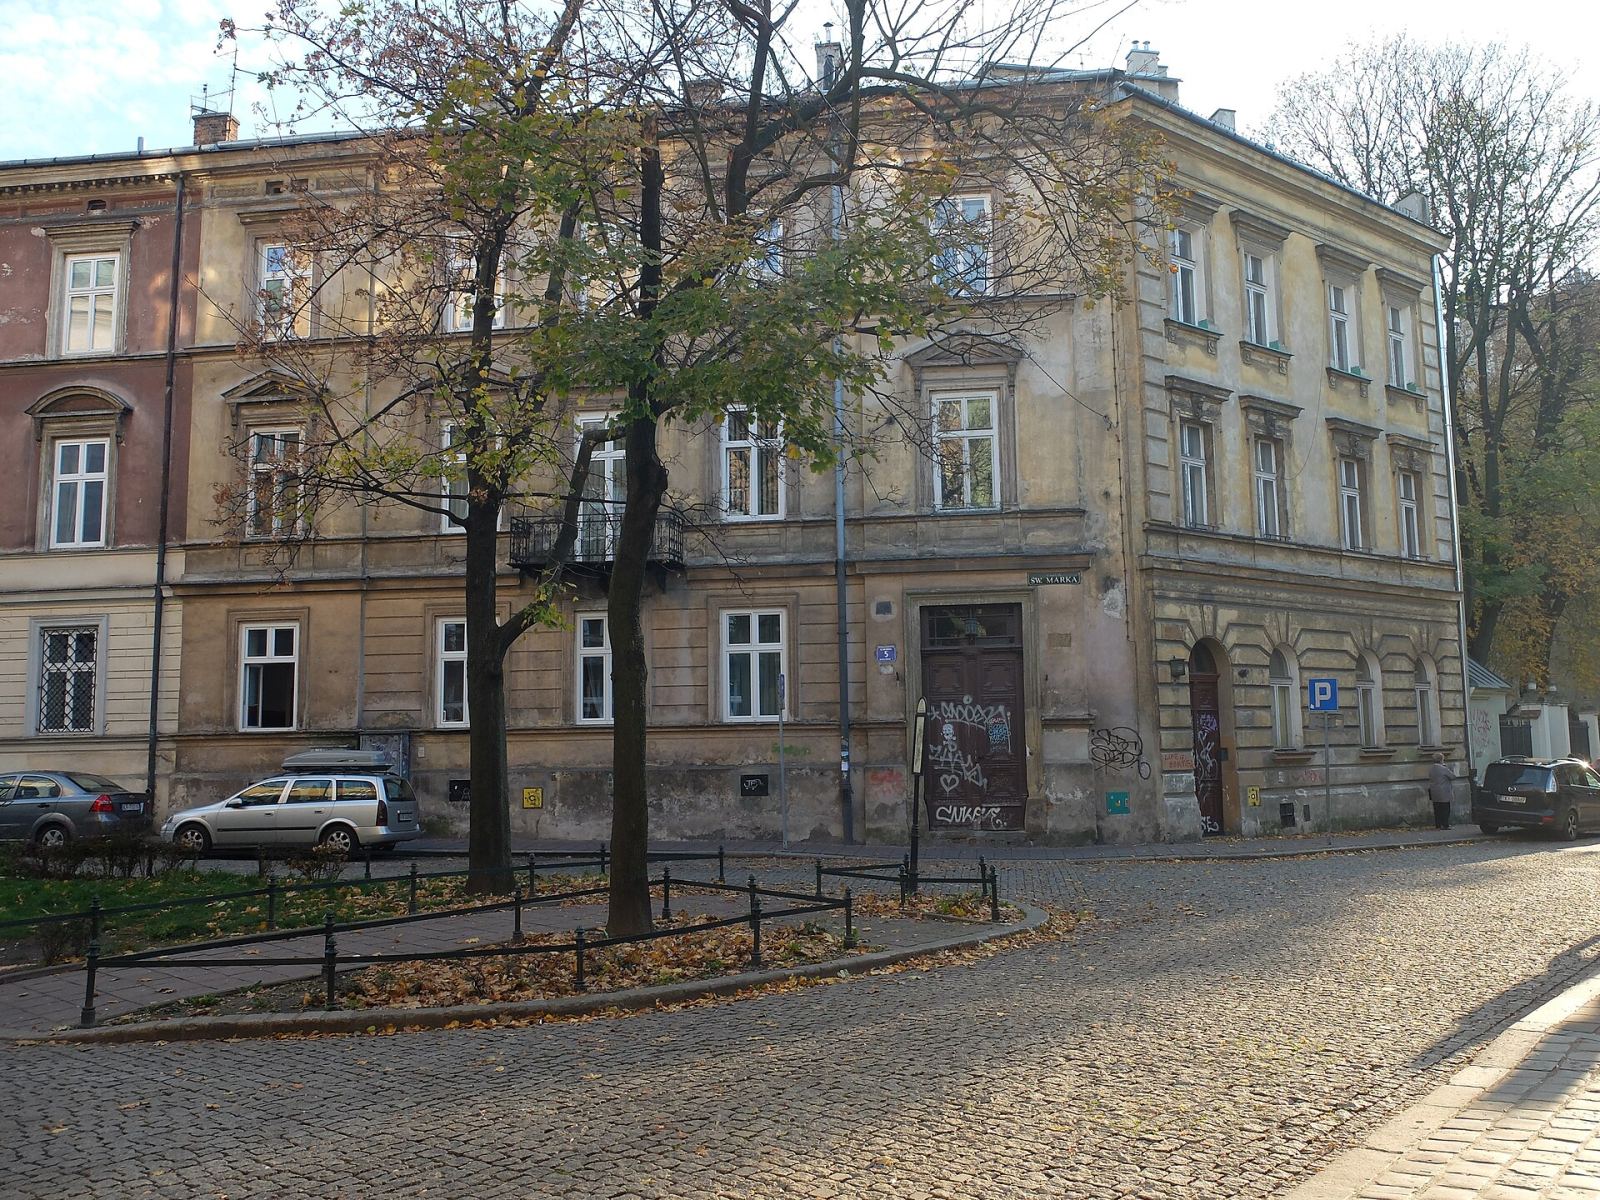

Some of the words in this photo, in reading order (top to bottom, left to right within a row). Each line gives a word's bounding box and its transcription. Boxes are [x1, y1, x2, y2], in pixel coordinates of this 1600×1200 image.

[1046, 576, 1078, 584] MARKA
[884, 650, 889, 658] 5
[1314, 682, 1331, 708] P
